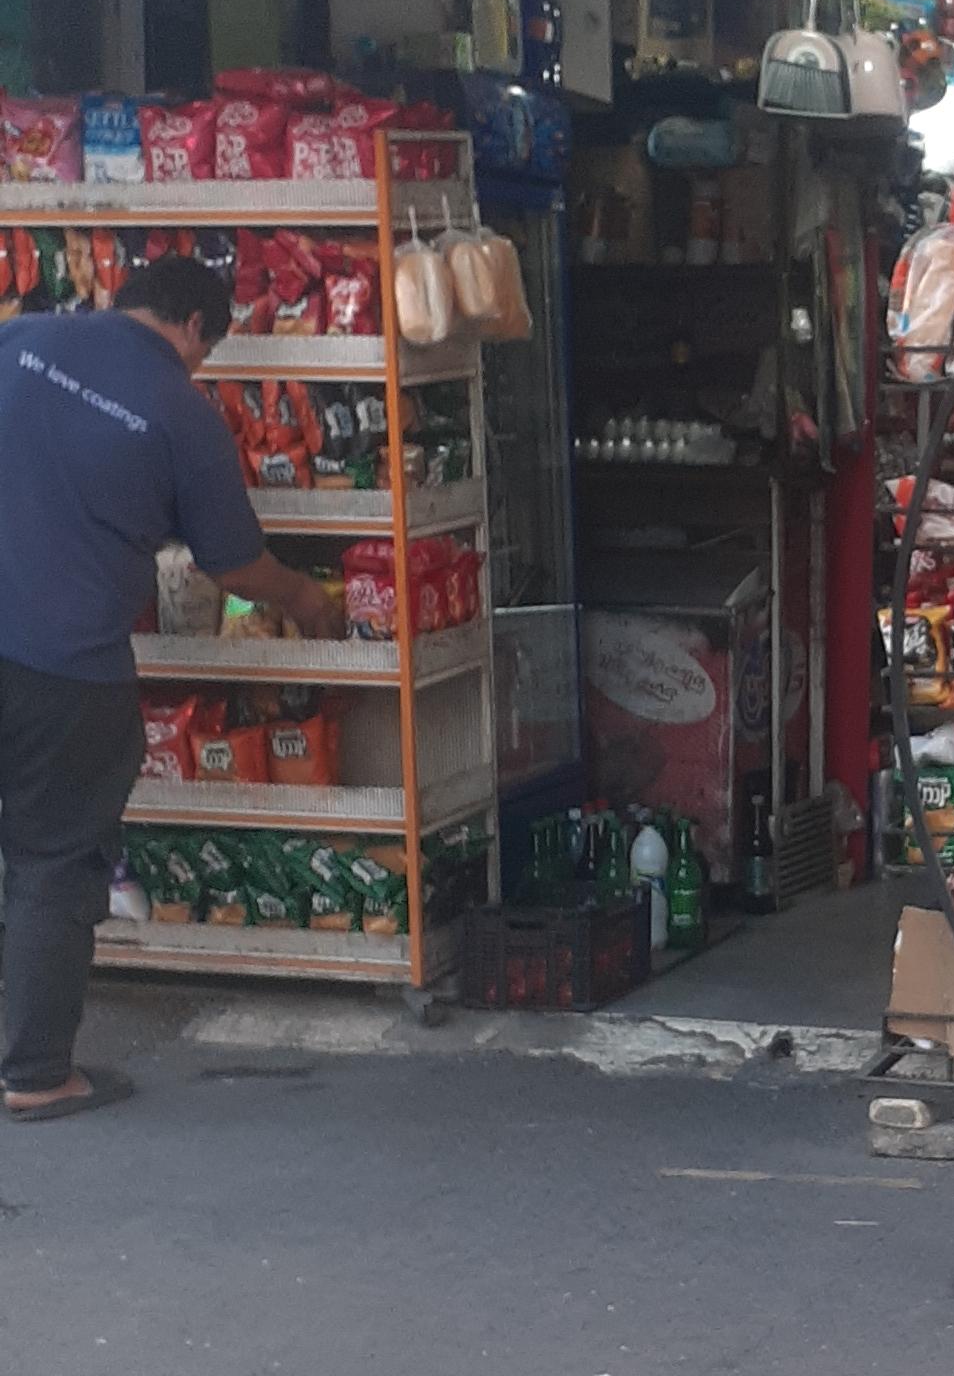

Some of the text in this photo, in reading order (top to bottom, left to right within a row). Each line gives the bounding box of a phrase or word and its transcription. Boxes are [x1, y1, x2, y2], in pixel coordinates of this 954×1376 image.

[18, 349, 148, 433] We love coatings
